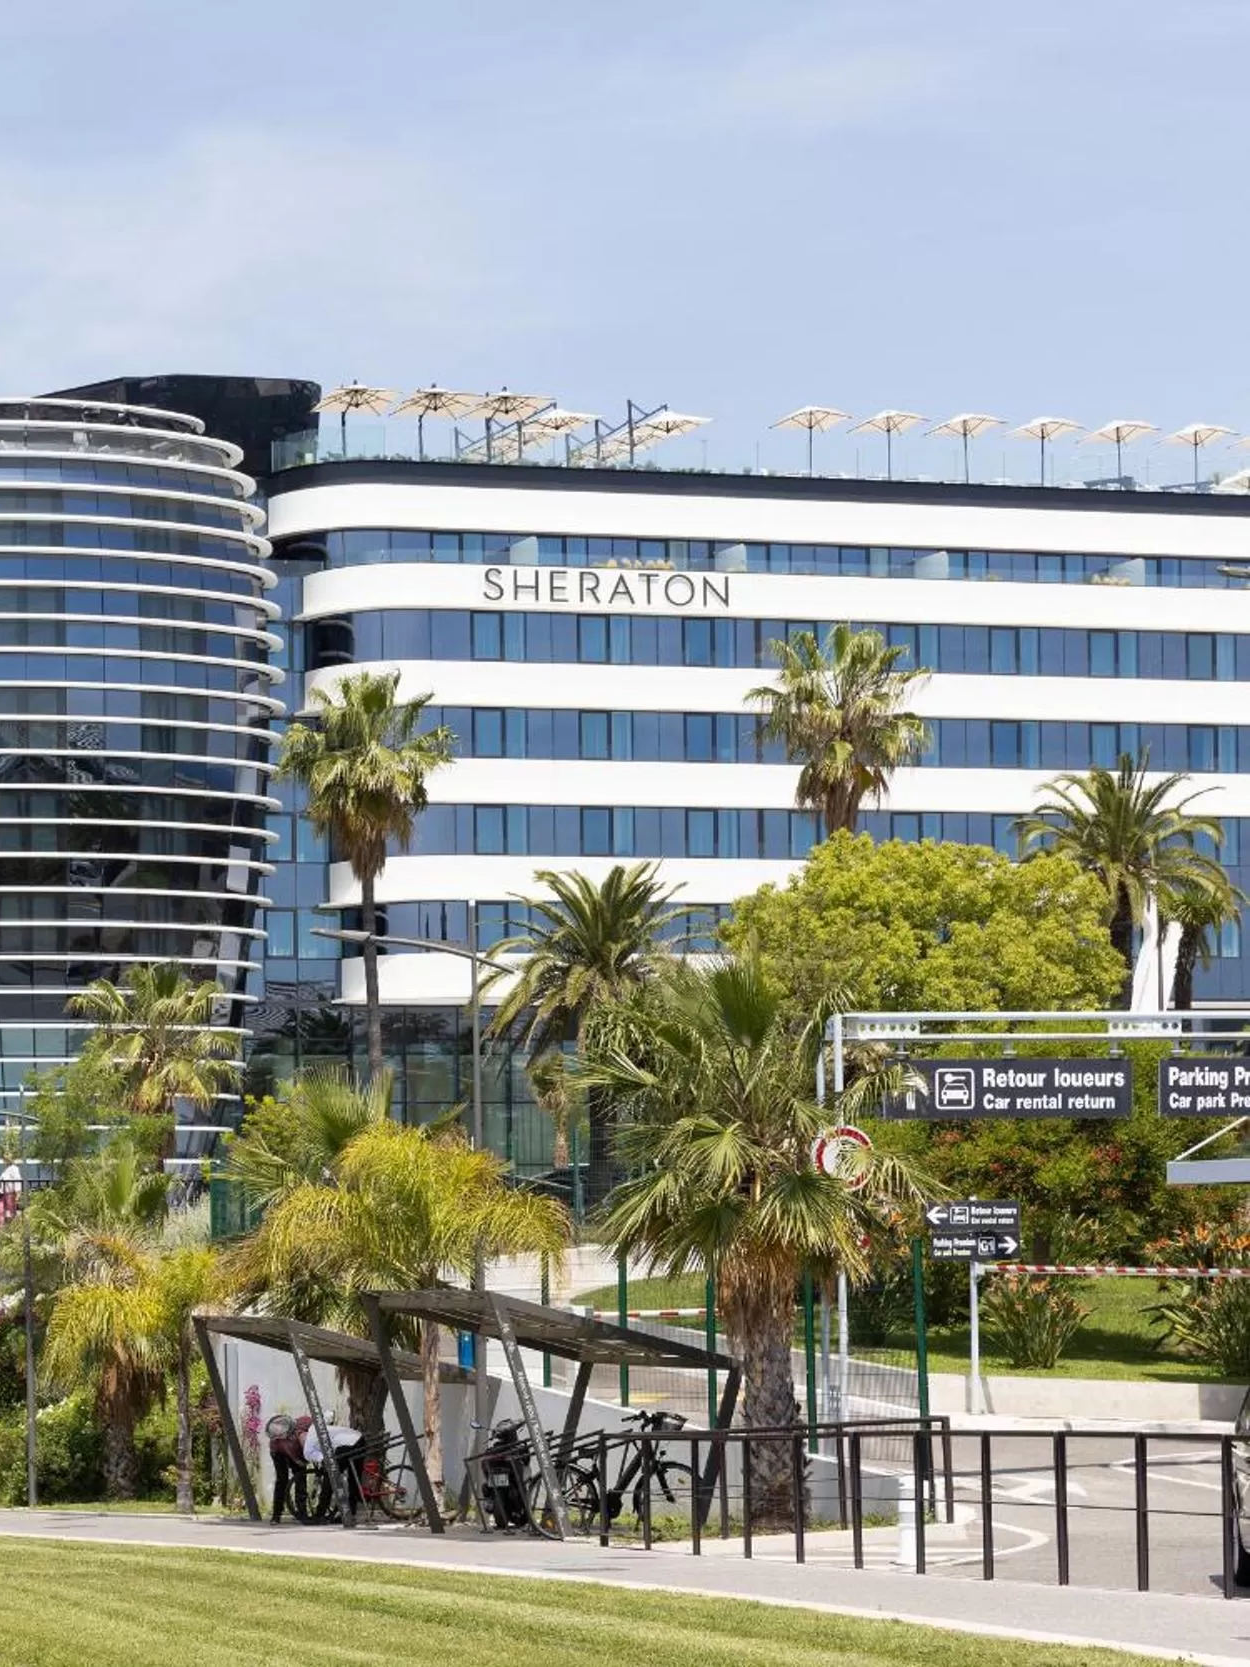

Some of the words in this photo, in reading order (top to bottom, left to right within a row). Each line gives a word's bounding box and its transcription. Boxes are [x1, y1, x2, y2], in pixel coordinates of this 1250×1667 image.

[483, 568, 729, 607] SHERATON
[982, 1068, 1046, 1088] Retour
[1054, 1067, 1126, 1088] loueurs
[1168, 1066, 1229, 1090] Parking
[983, 1093, 1010, 1110] Car
[1016, 1094, 1062, 1110] rental
[1067, 1095, 1116, 1110] return
[1169, 1092, 1192, 1109] Car
[1196, 1092, 1226, 1112] park
